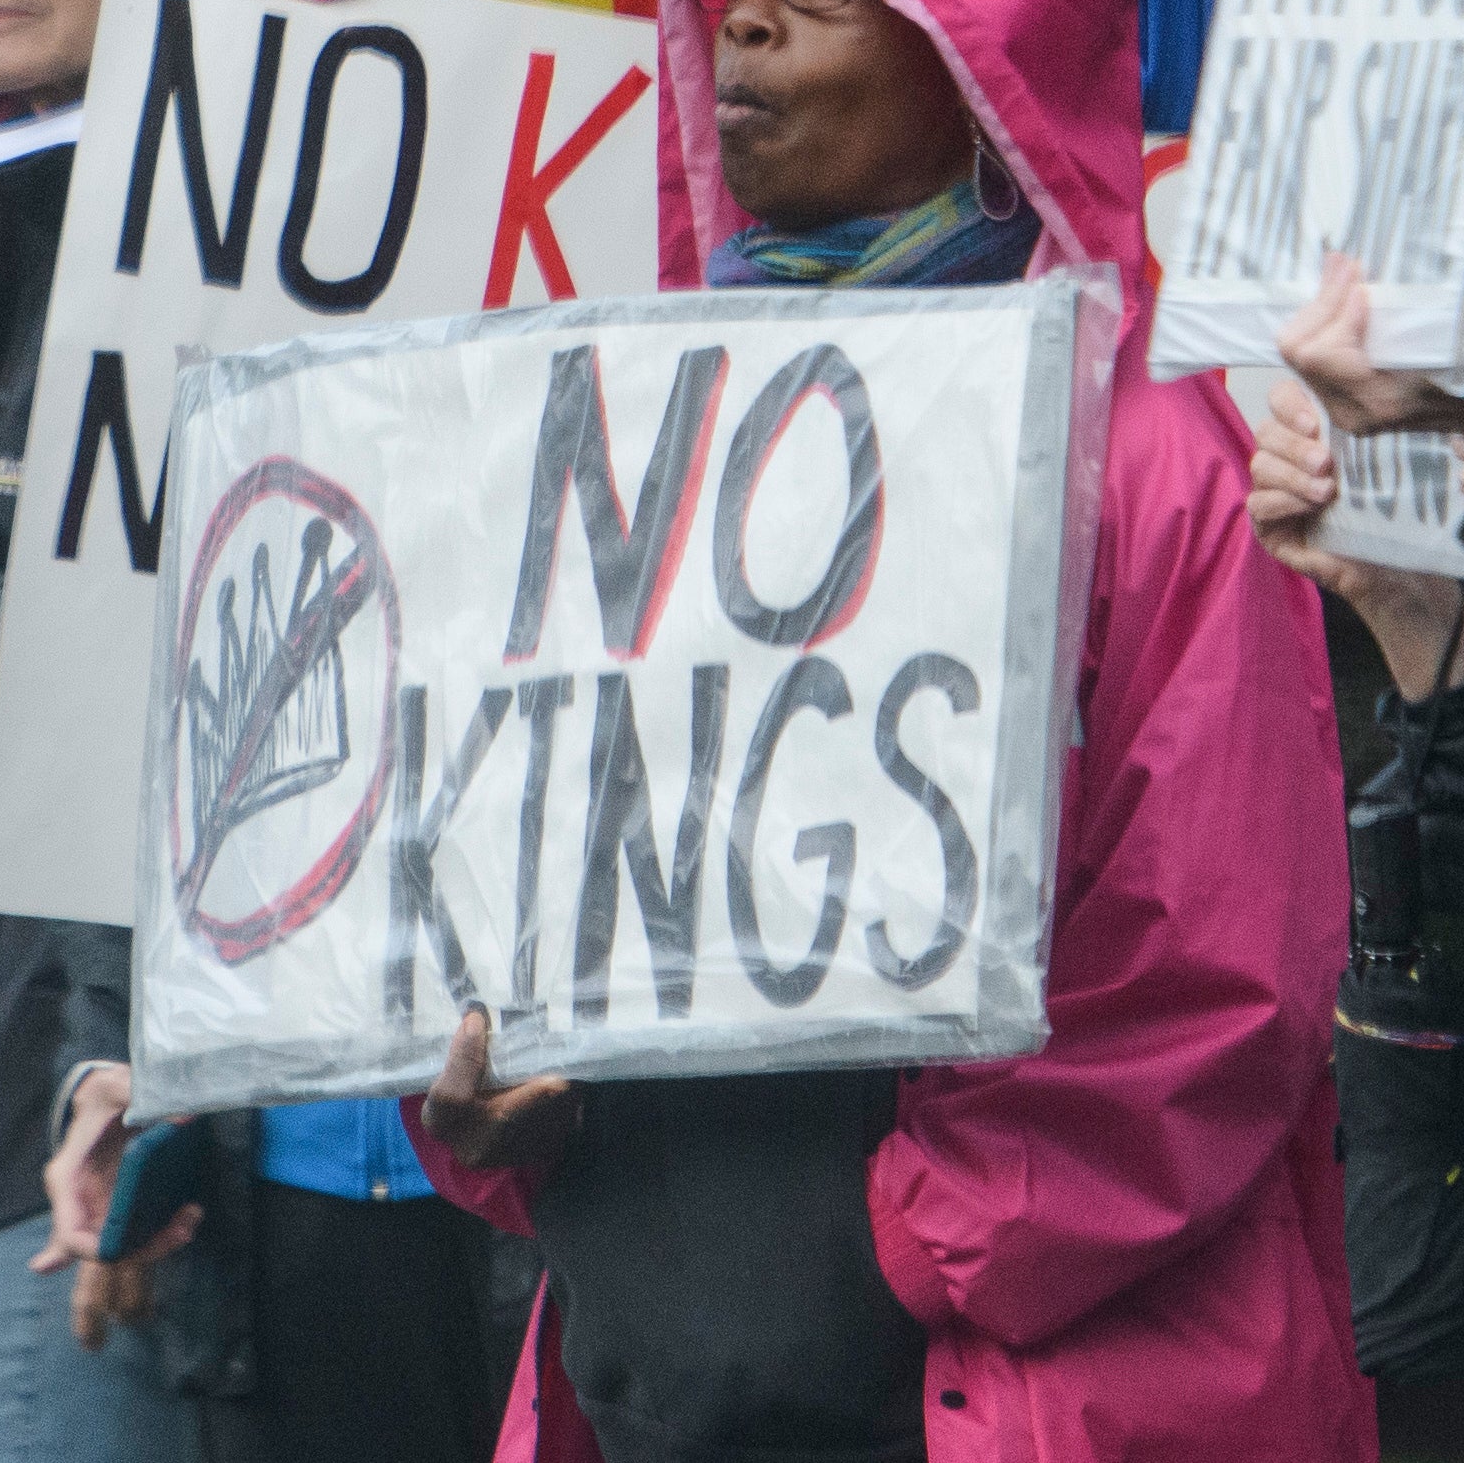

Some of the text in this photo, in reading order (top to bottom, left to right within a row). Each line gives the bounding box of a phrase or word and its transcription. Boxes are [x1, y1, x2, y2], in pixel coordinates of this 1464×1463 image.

[1188, 38, 1335, 280] FAIR
[503, 344, 884, 665] NO
[385, 650, 981, 1032] KINGS
